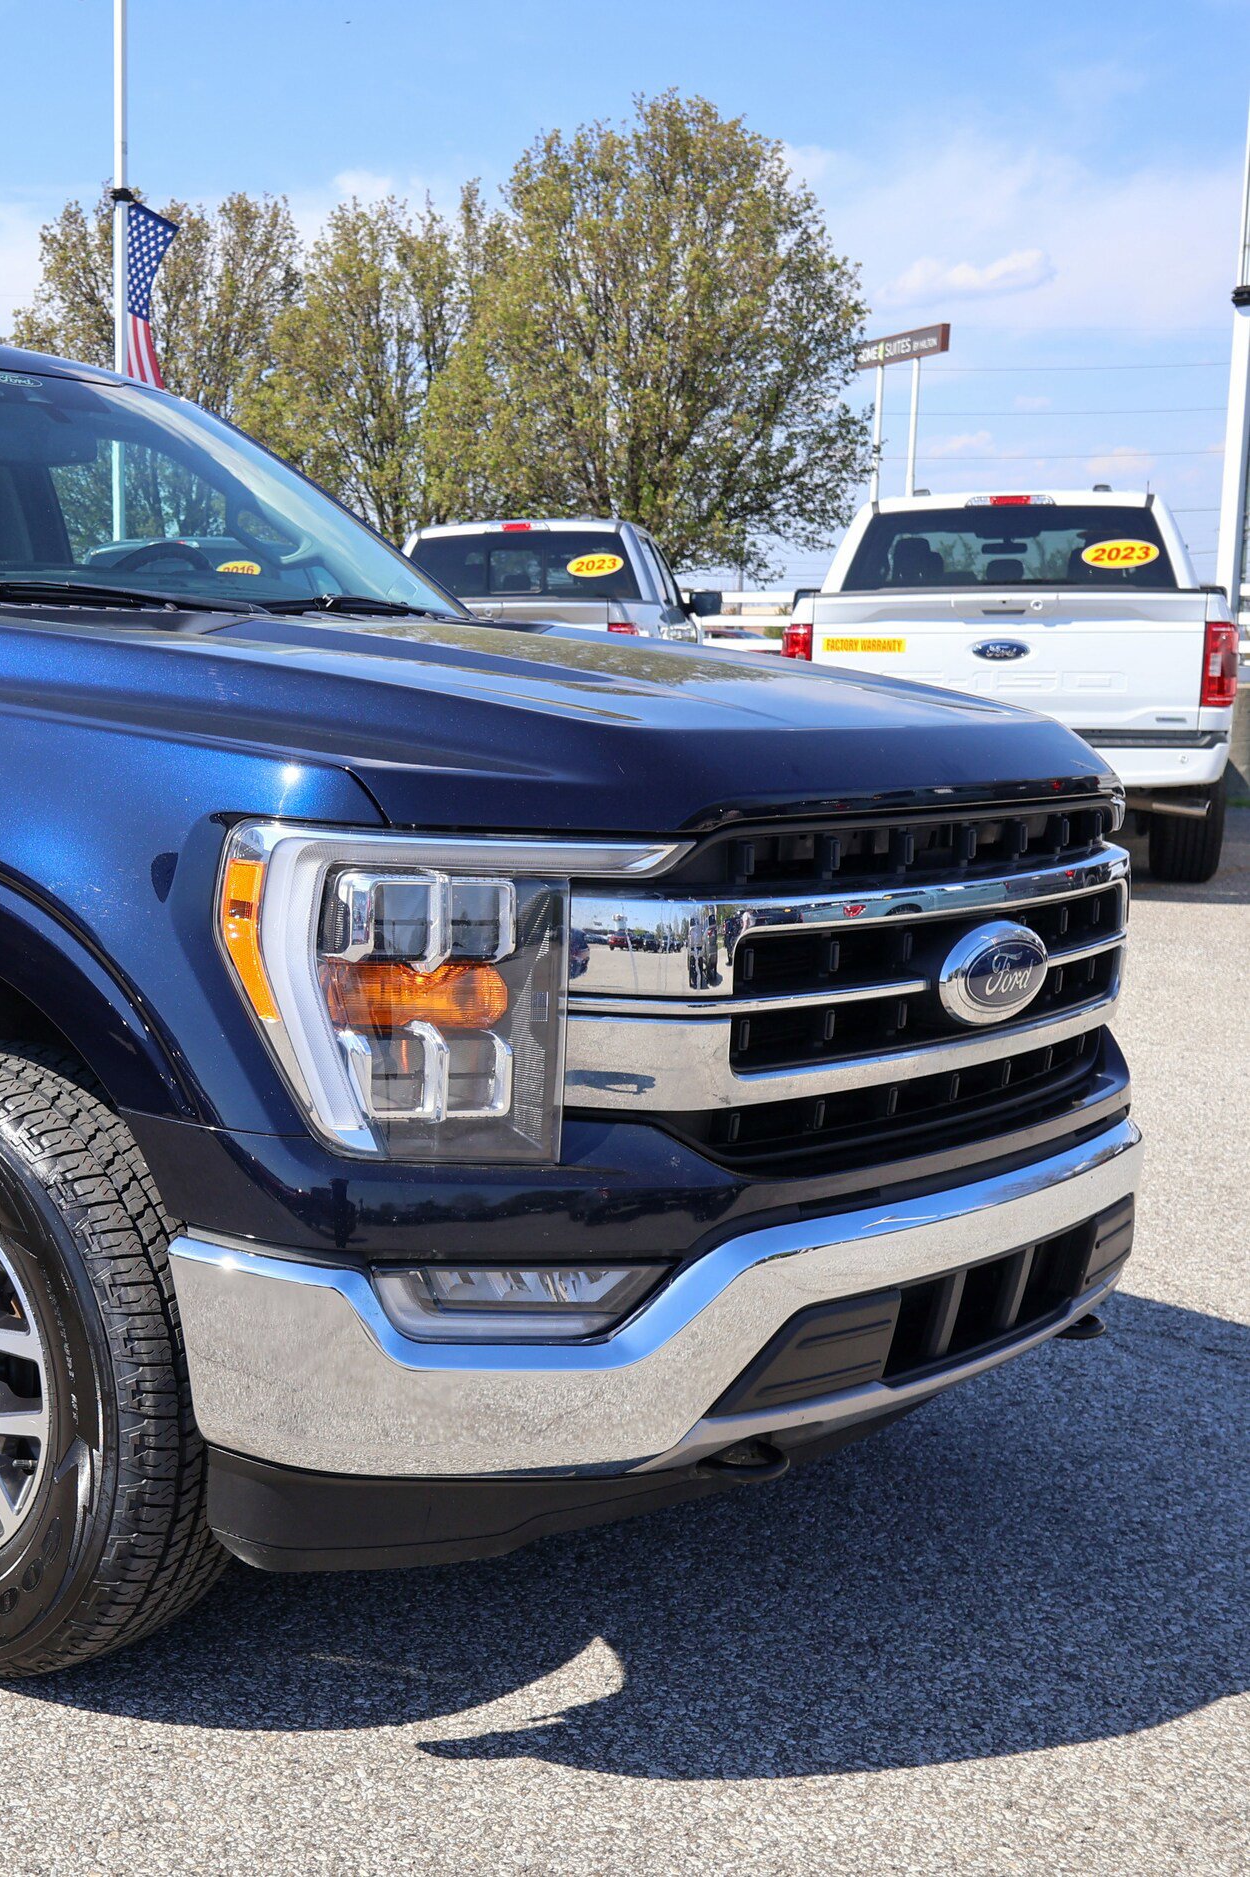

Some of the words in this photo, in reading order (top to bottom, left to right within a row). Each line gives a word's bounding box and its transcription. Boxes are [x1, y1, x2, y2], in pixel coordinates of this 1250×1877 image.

[885, 337, 912, 358] SUITES
[1089, 544, 1152, 563] 2023
[573, 557, 619, 573] 2023
[826, 638, 859, 652] FACTORY
[860, 638, 903, 652] WARRANTY
[984, 950, 1034, 997] Ford
